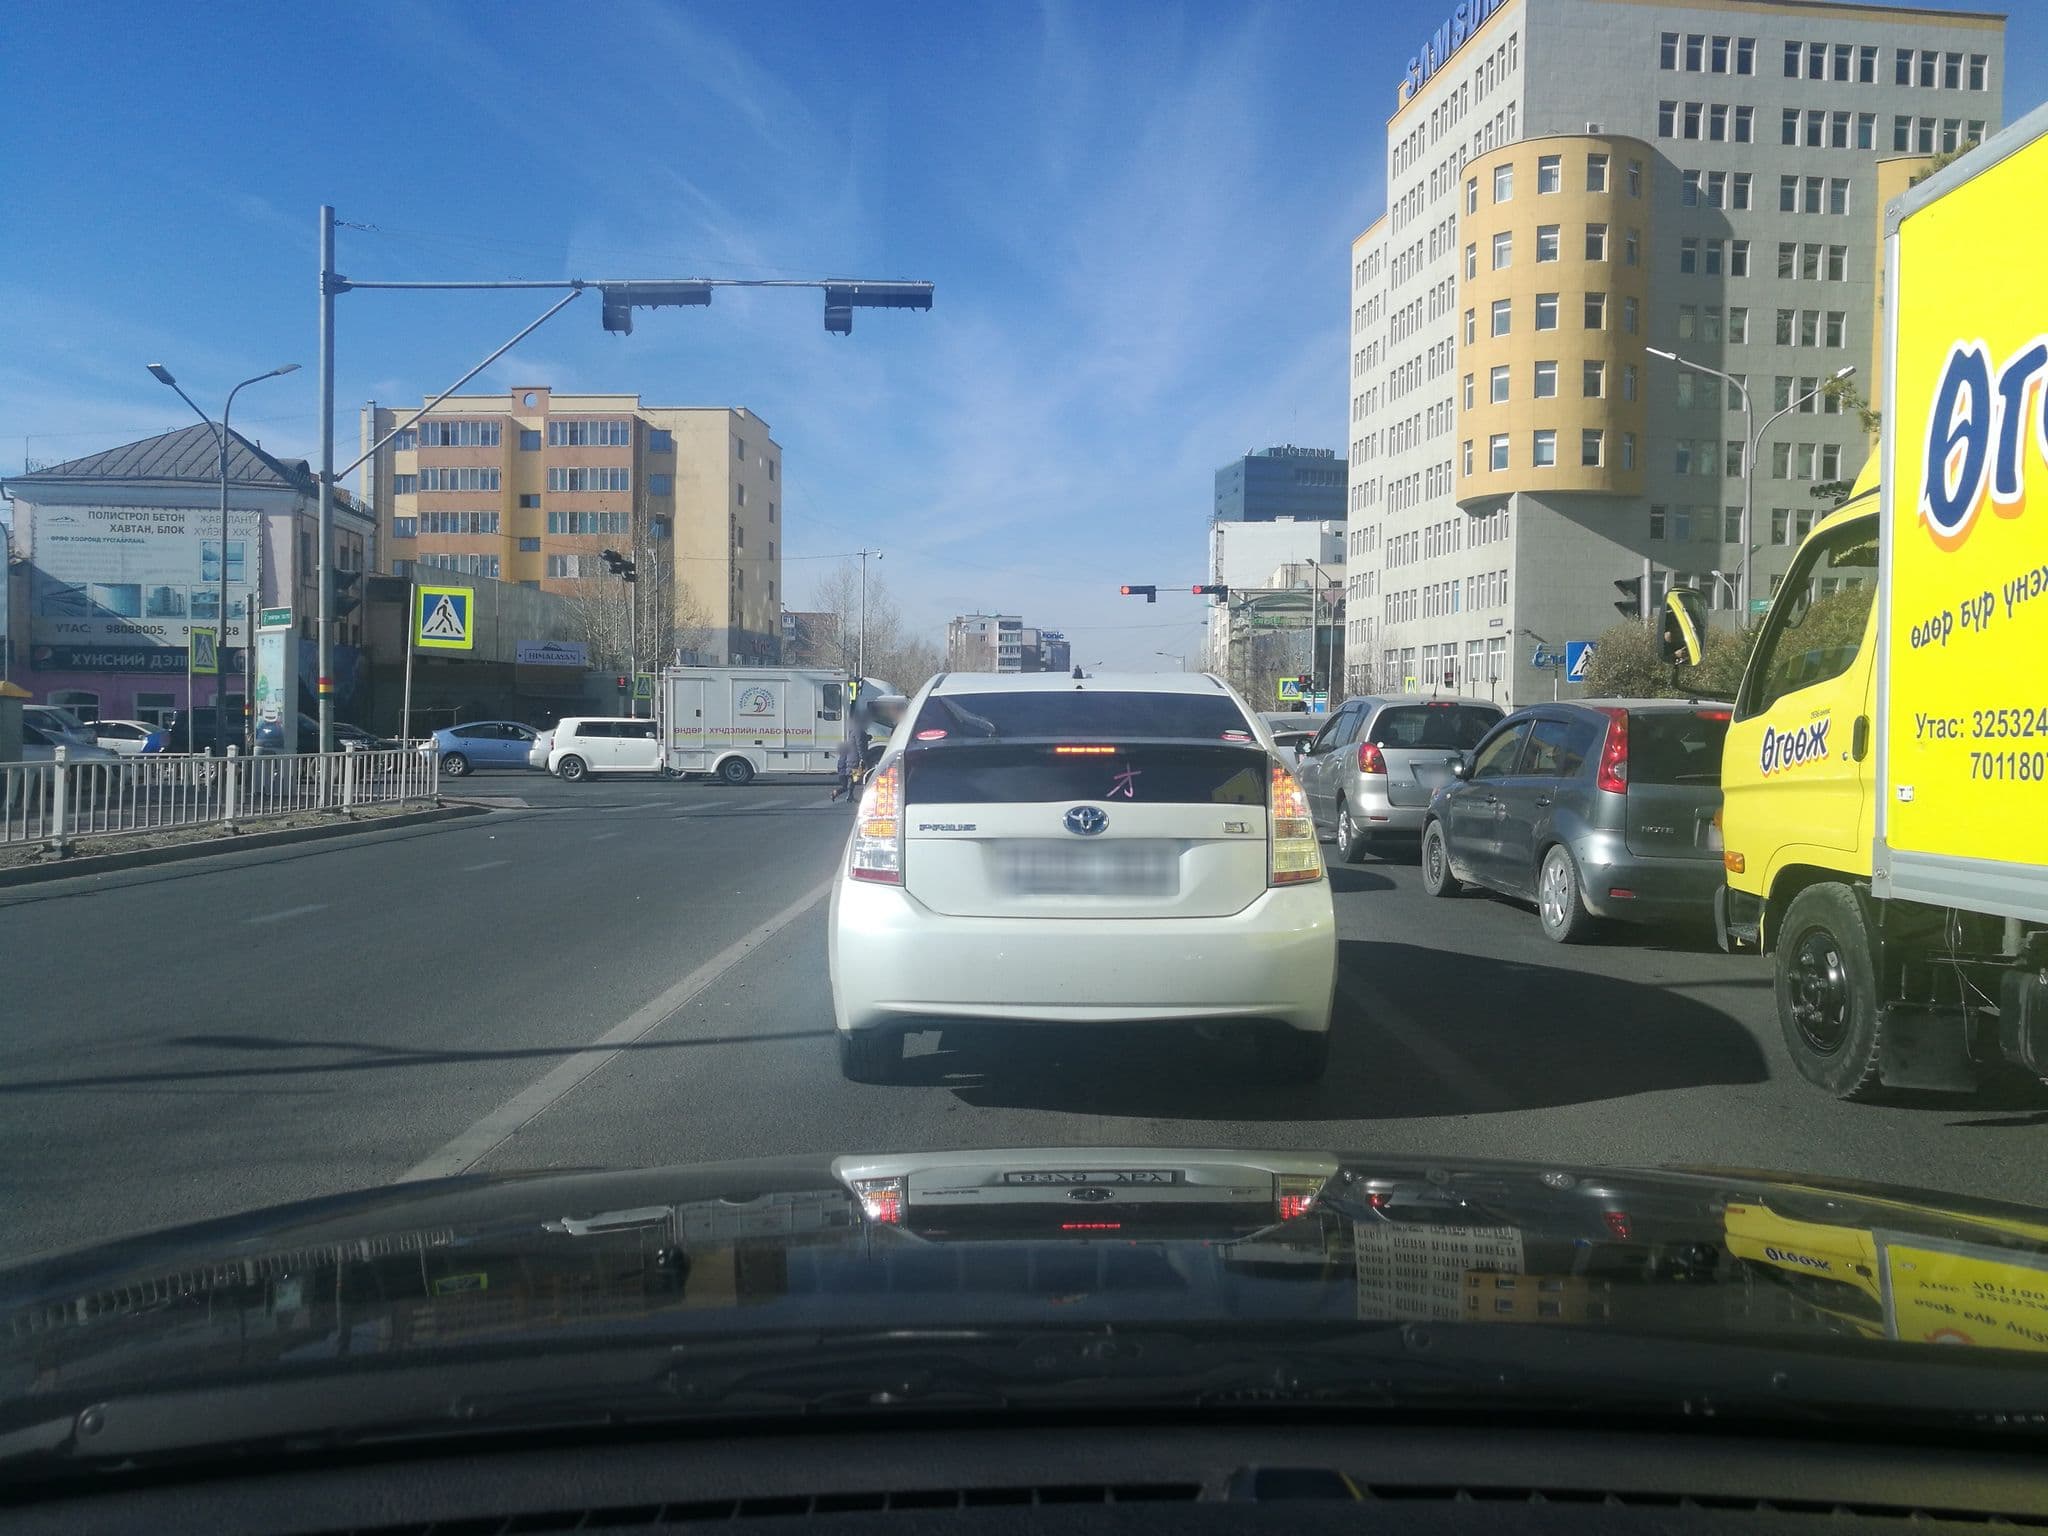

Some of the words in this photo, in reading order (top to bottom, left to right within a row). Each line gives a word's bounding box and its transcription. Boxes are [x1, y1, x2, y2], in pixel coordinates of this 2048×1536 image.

[1918, 337, 2048, 553] Өг
[88, 510, 149, 521] ПОЛИСТРОЛ
[152, 512, 185, 523] БЕТОН
[109, 524, 154, 535] ХАВТАН,
[157, 526, 185, 535] БЛОК
[674, 727, 703, 735] ӨНДӨР
[1915, 713, 1965, 739] Утас:
[1971, 752, 2048, 781] 701180
[919, 823, 976, 831] PRIUS
